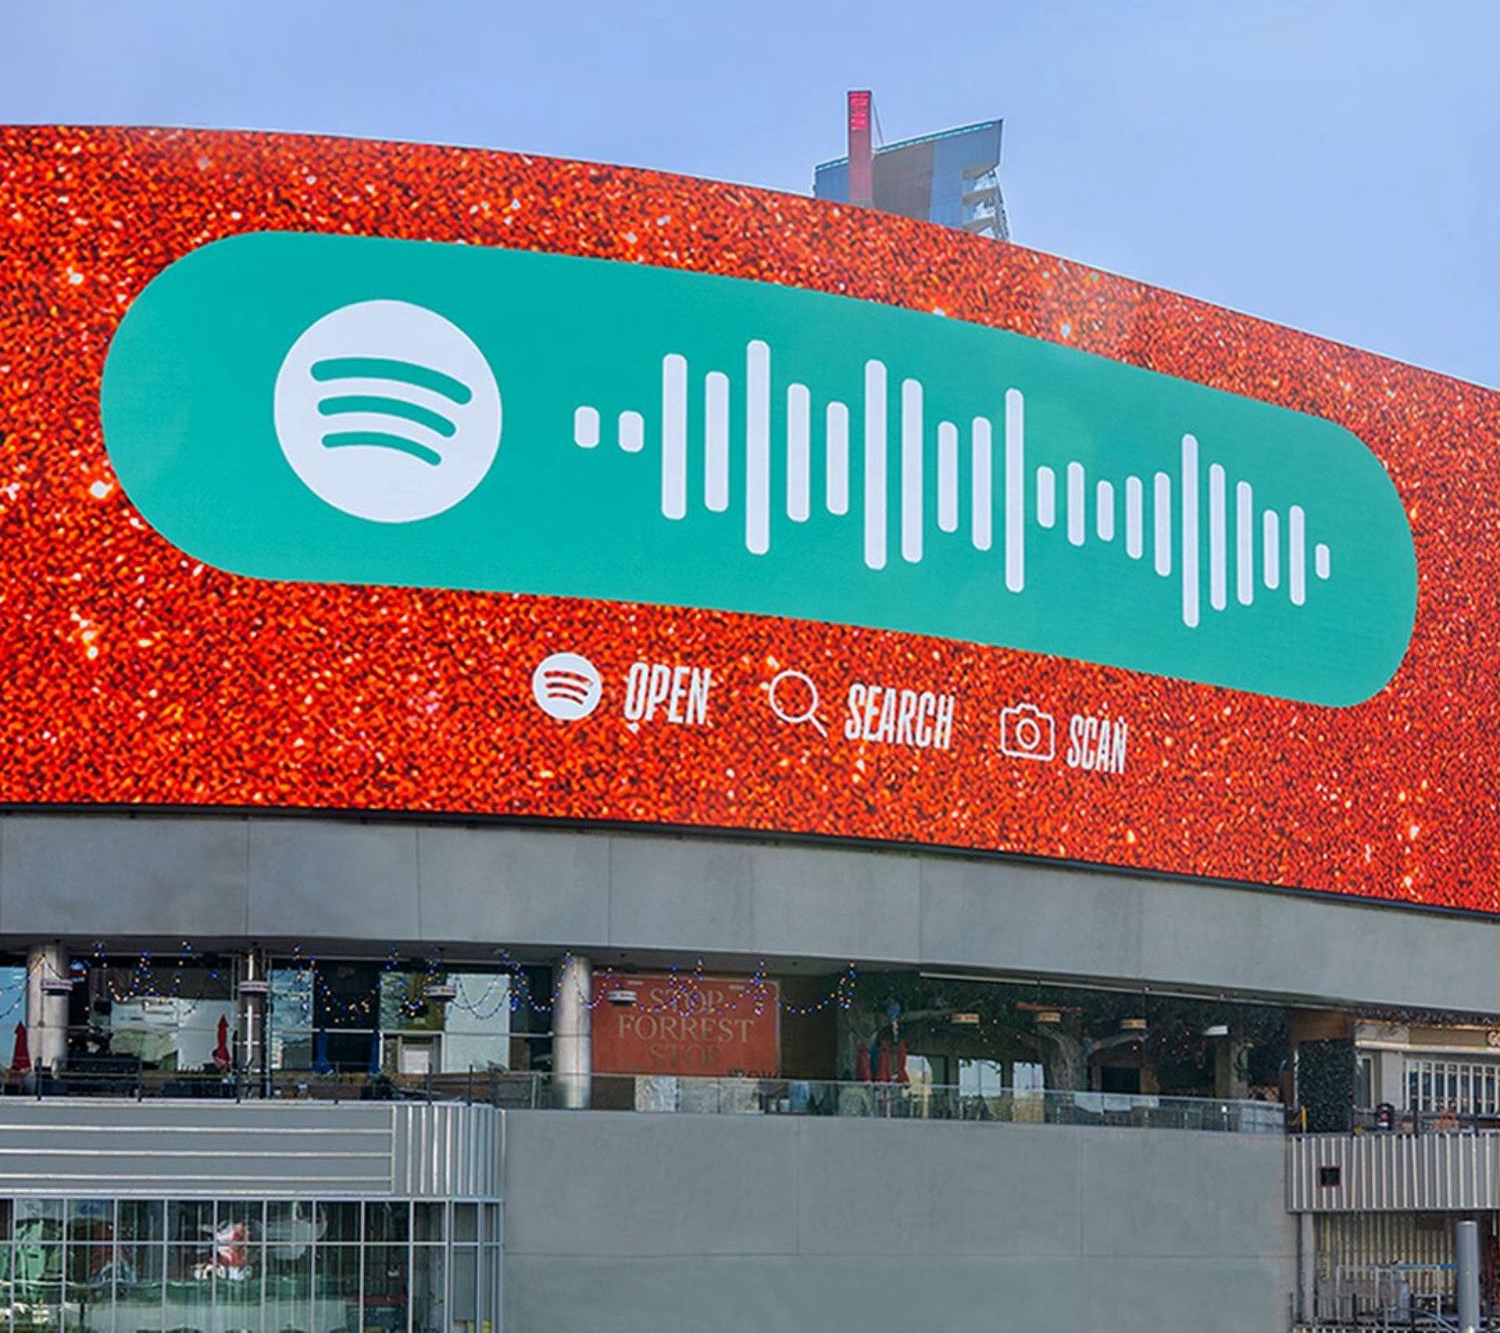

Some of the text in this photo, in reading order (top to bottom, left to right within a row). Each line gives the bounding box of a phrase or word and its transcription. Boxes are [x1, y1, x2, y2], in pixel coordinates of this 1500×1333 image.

[623, 661, 1127, 775] OPEN SEARCH SCAN
[650, 987, 724, 1014] STOP
[618, 1013, 755, 1044] FORREST
[650, 1042, 724, 1068] STOP
